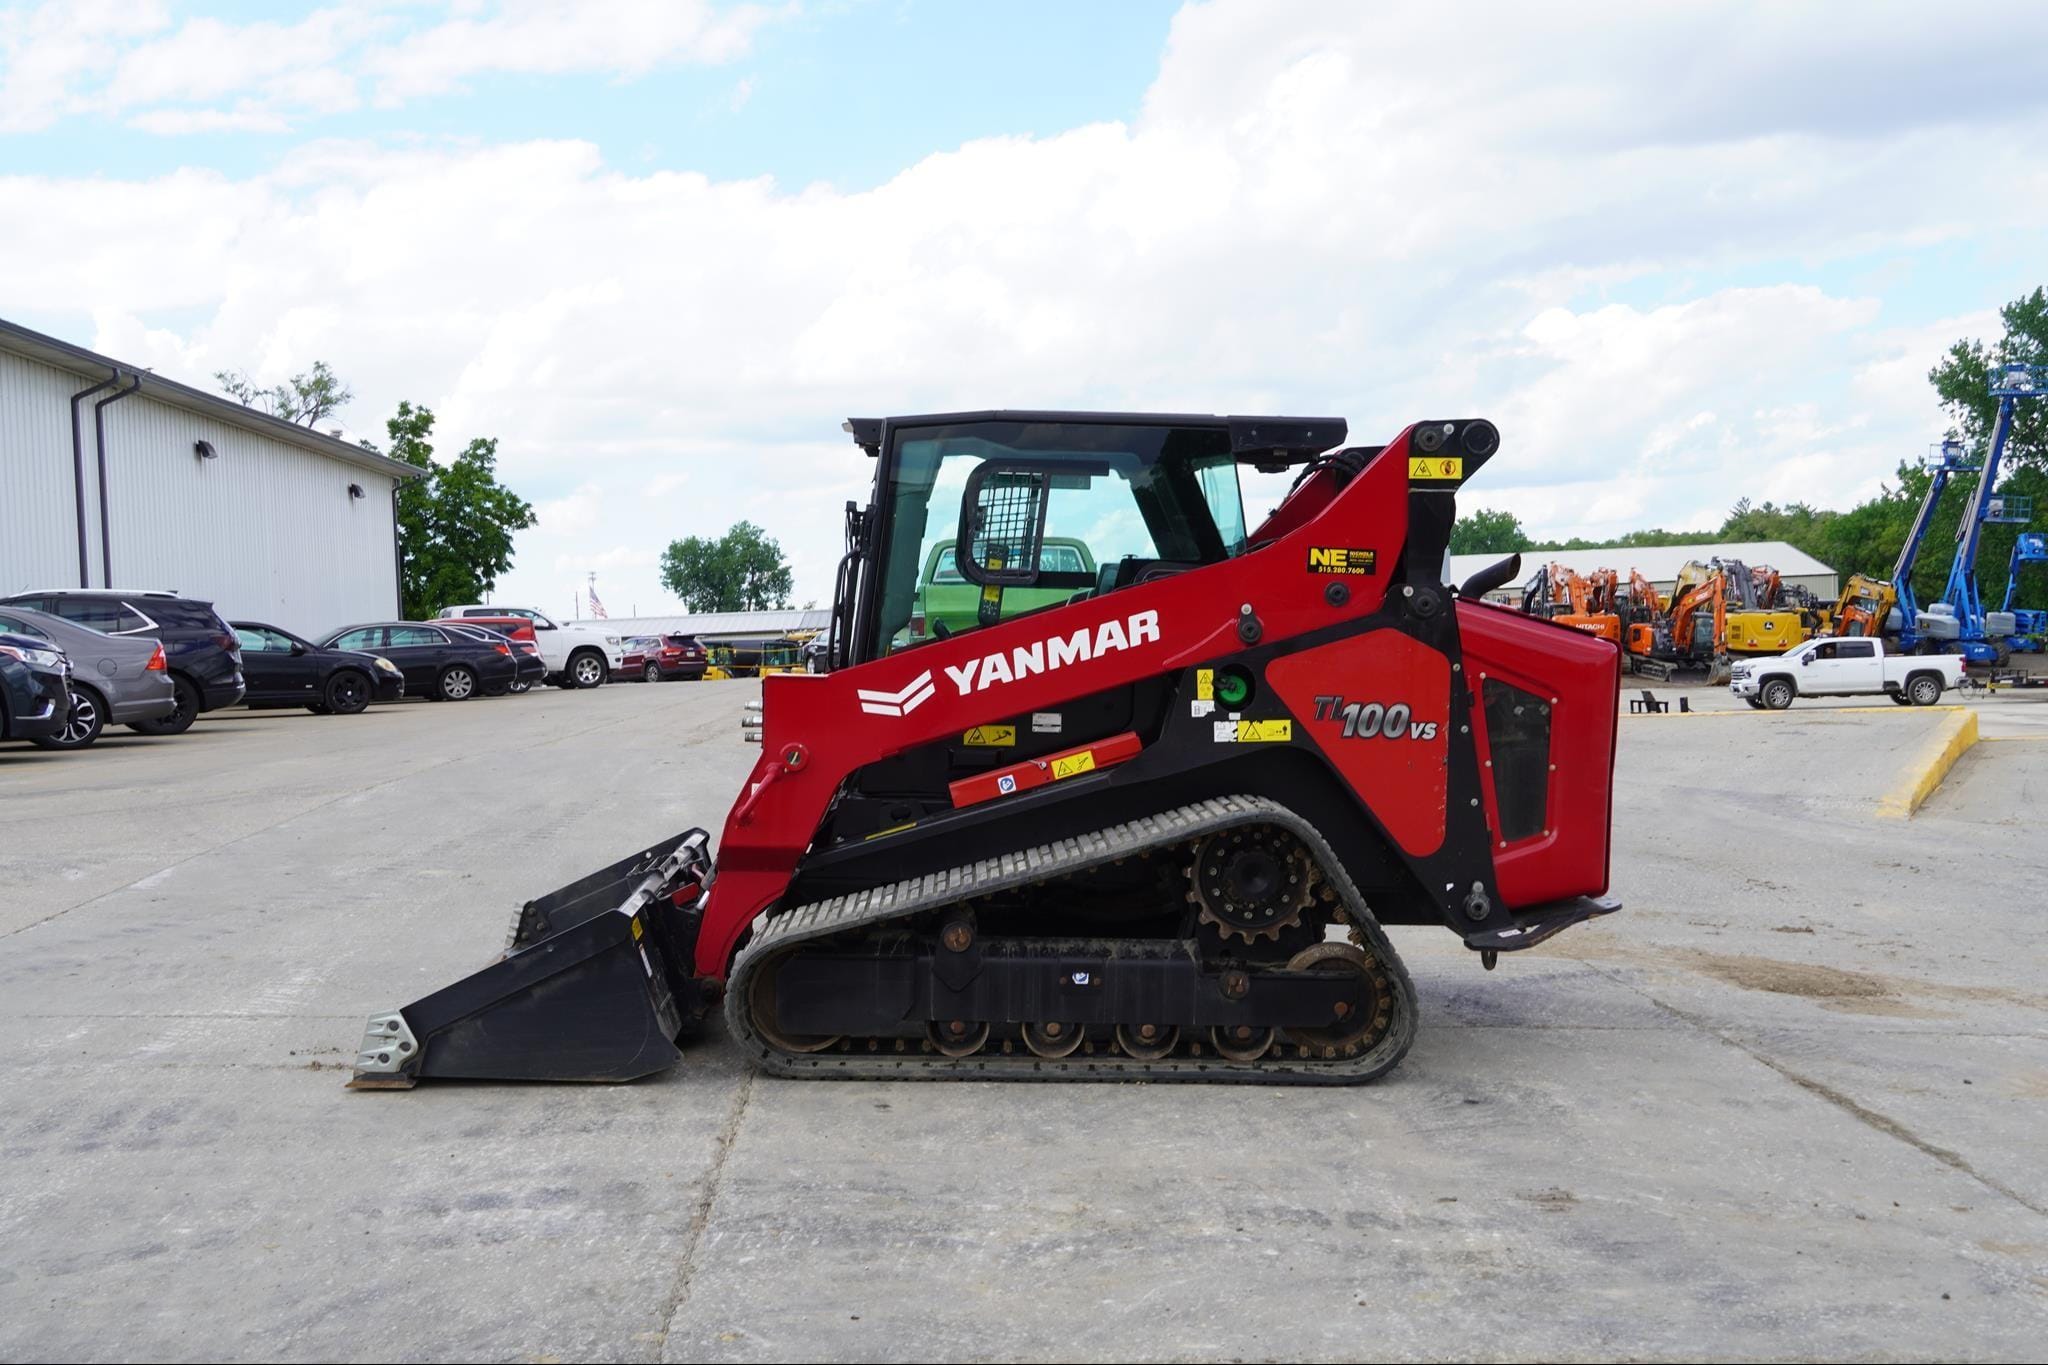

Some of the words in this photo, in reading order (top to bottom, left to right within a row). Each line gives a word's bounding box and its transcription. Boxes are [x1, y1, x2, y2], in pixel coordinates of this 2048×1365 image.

[1310, 548, 1348, 567] NE
[1575, 623, 1605, 631] HITACHI
[944, 609, 1160, 696] YANMAR
